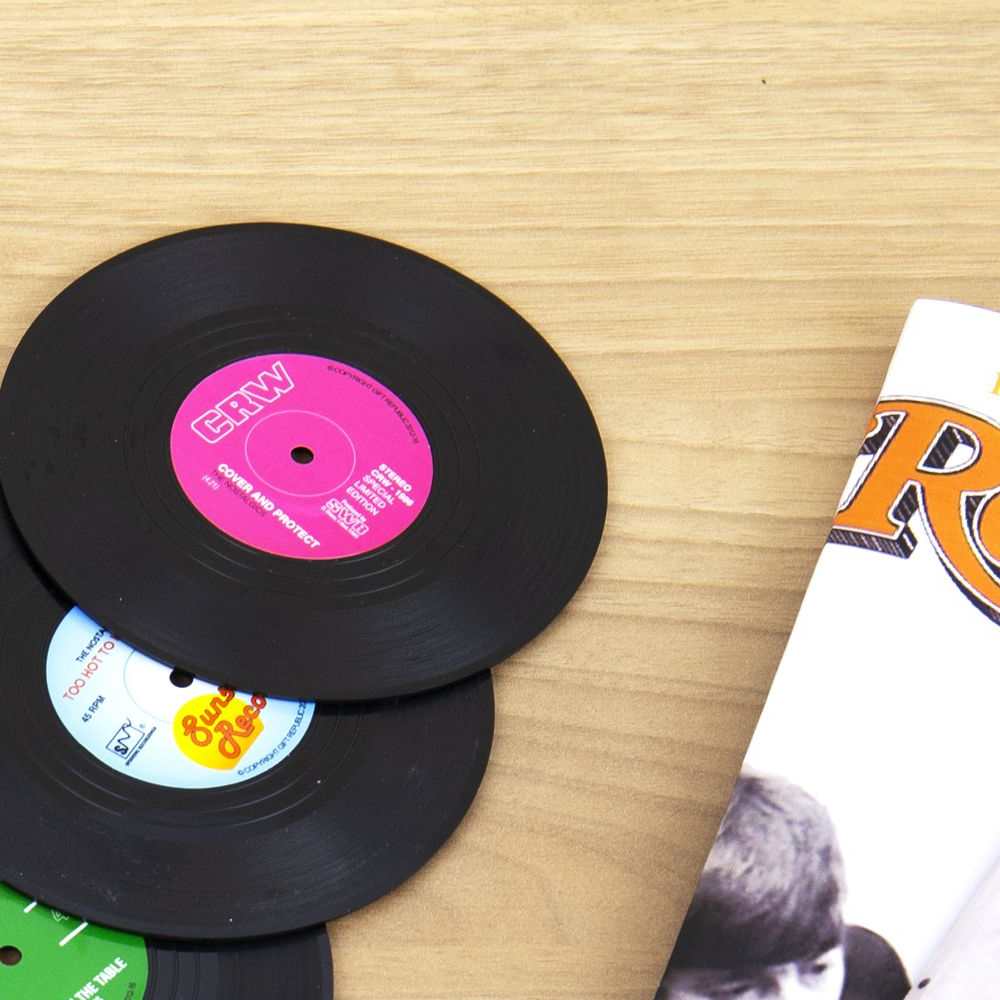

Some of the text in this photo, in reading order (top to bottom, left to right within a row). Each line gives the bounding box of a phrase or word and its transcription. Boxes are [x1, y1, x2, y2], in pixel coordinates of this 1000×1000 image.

[191, 360, 295, 444] CRW
[362, 474, 395, 505] SPECIAL
[370, 469, 392, 487] CRW
[379, 463, 412, 492] STEREO
[218, 463, 254, 494] COVER
[251, 491, 275, 512] AND
[272, 508, 321, 548] PROTECT
[346, 486, 380, 516] EDITION
[353, 480, 386, 509] LIMITED
[62, 640, 115, 701] TOO HOT TO
[75, 650, 90, 664] THE
[81, 695, 106, 724] 45 RPM
[92, 957, 128, 986] TABLE
